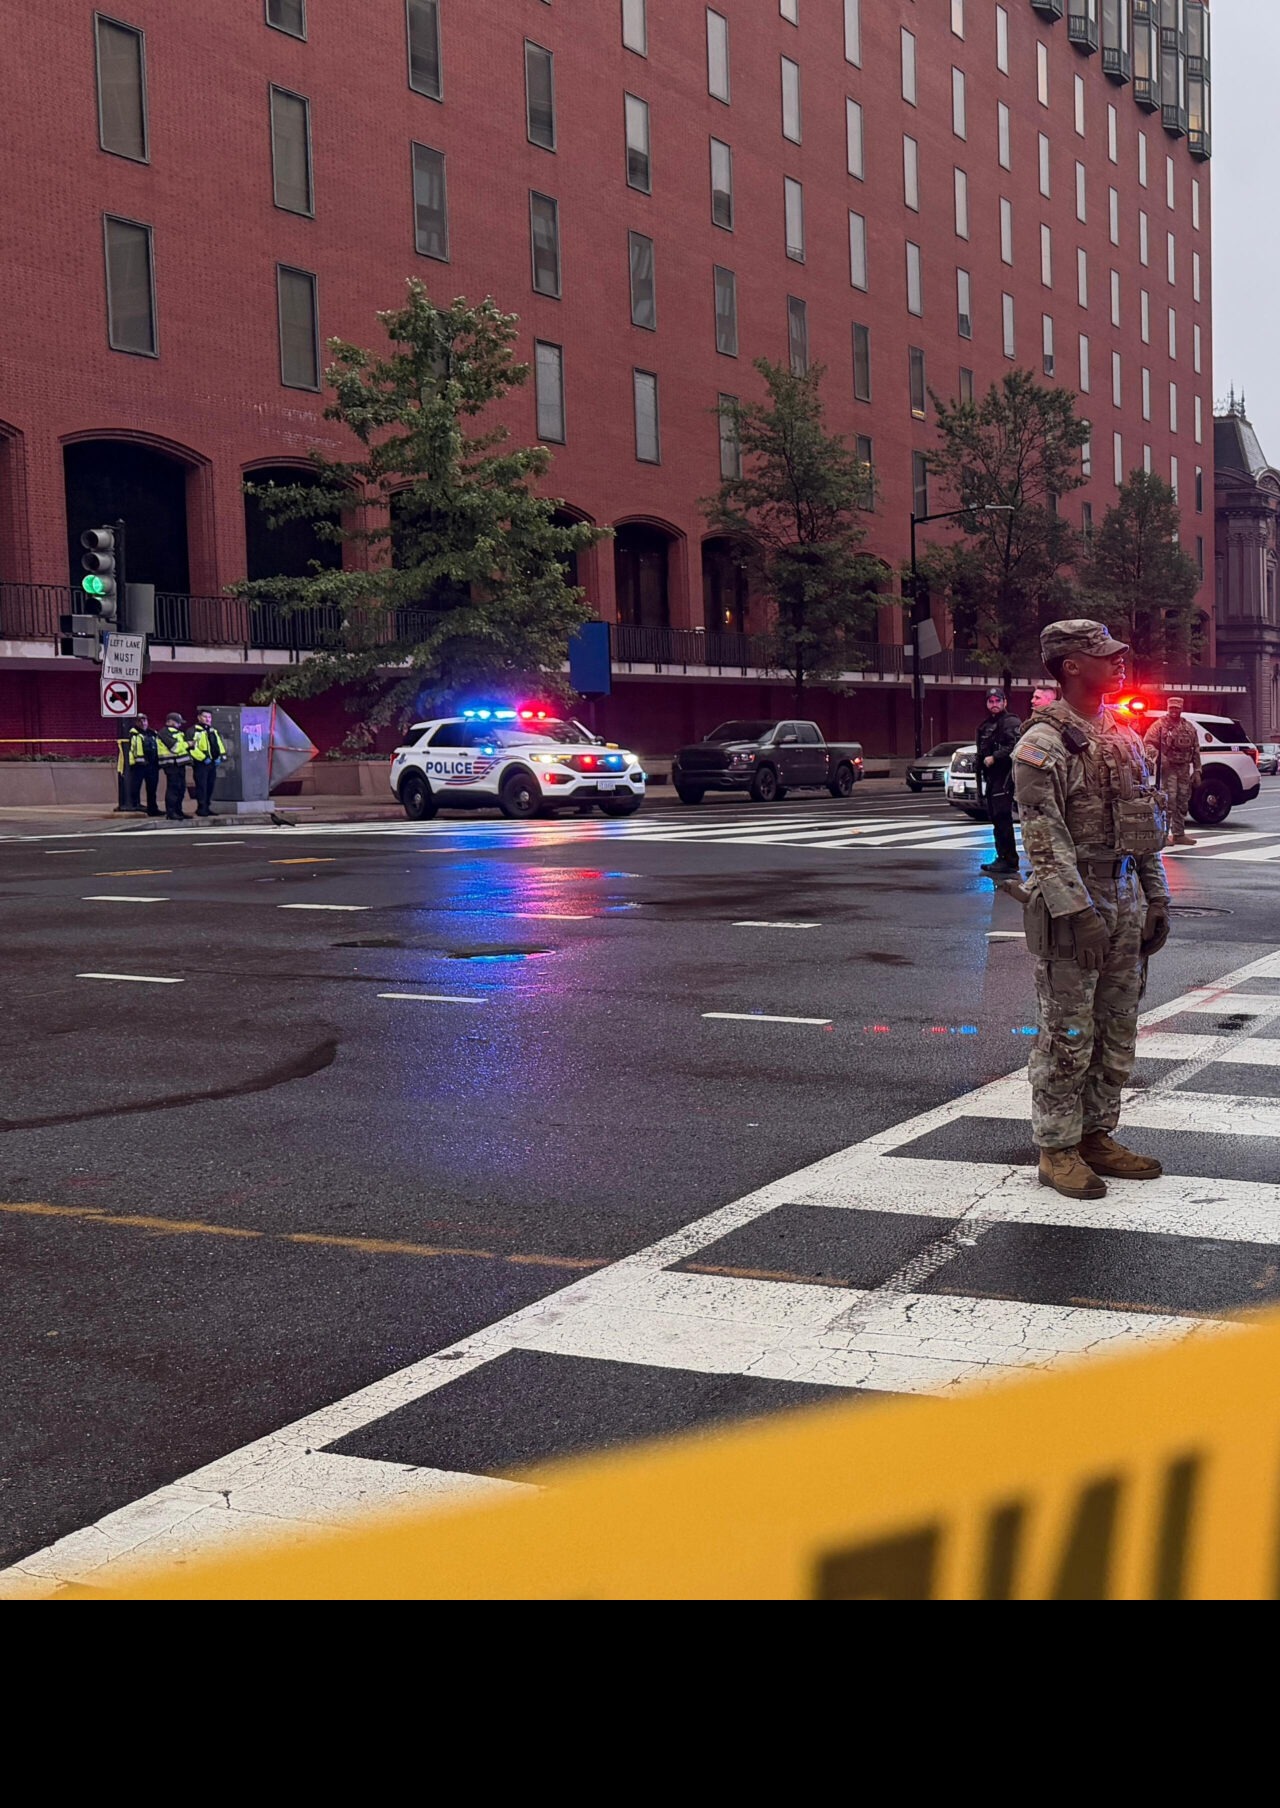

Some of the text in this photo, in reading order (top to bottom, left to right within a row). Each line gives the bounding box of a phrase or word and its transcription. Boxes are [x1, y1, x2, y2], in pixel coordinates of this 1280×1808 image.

[110, 639, 141, 649] LEFT LANE
[114, 652, 134, 662] MUST
[107, 665, 139, 676] TURN LEFT
[426, 761, 473, 775] POLICE
